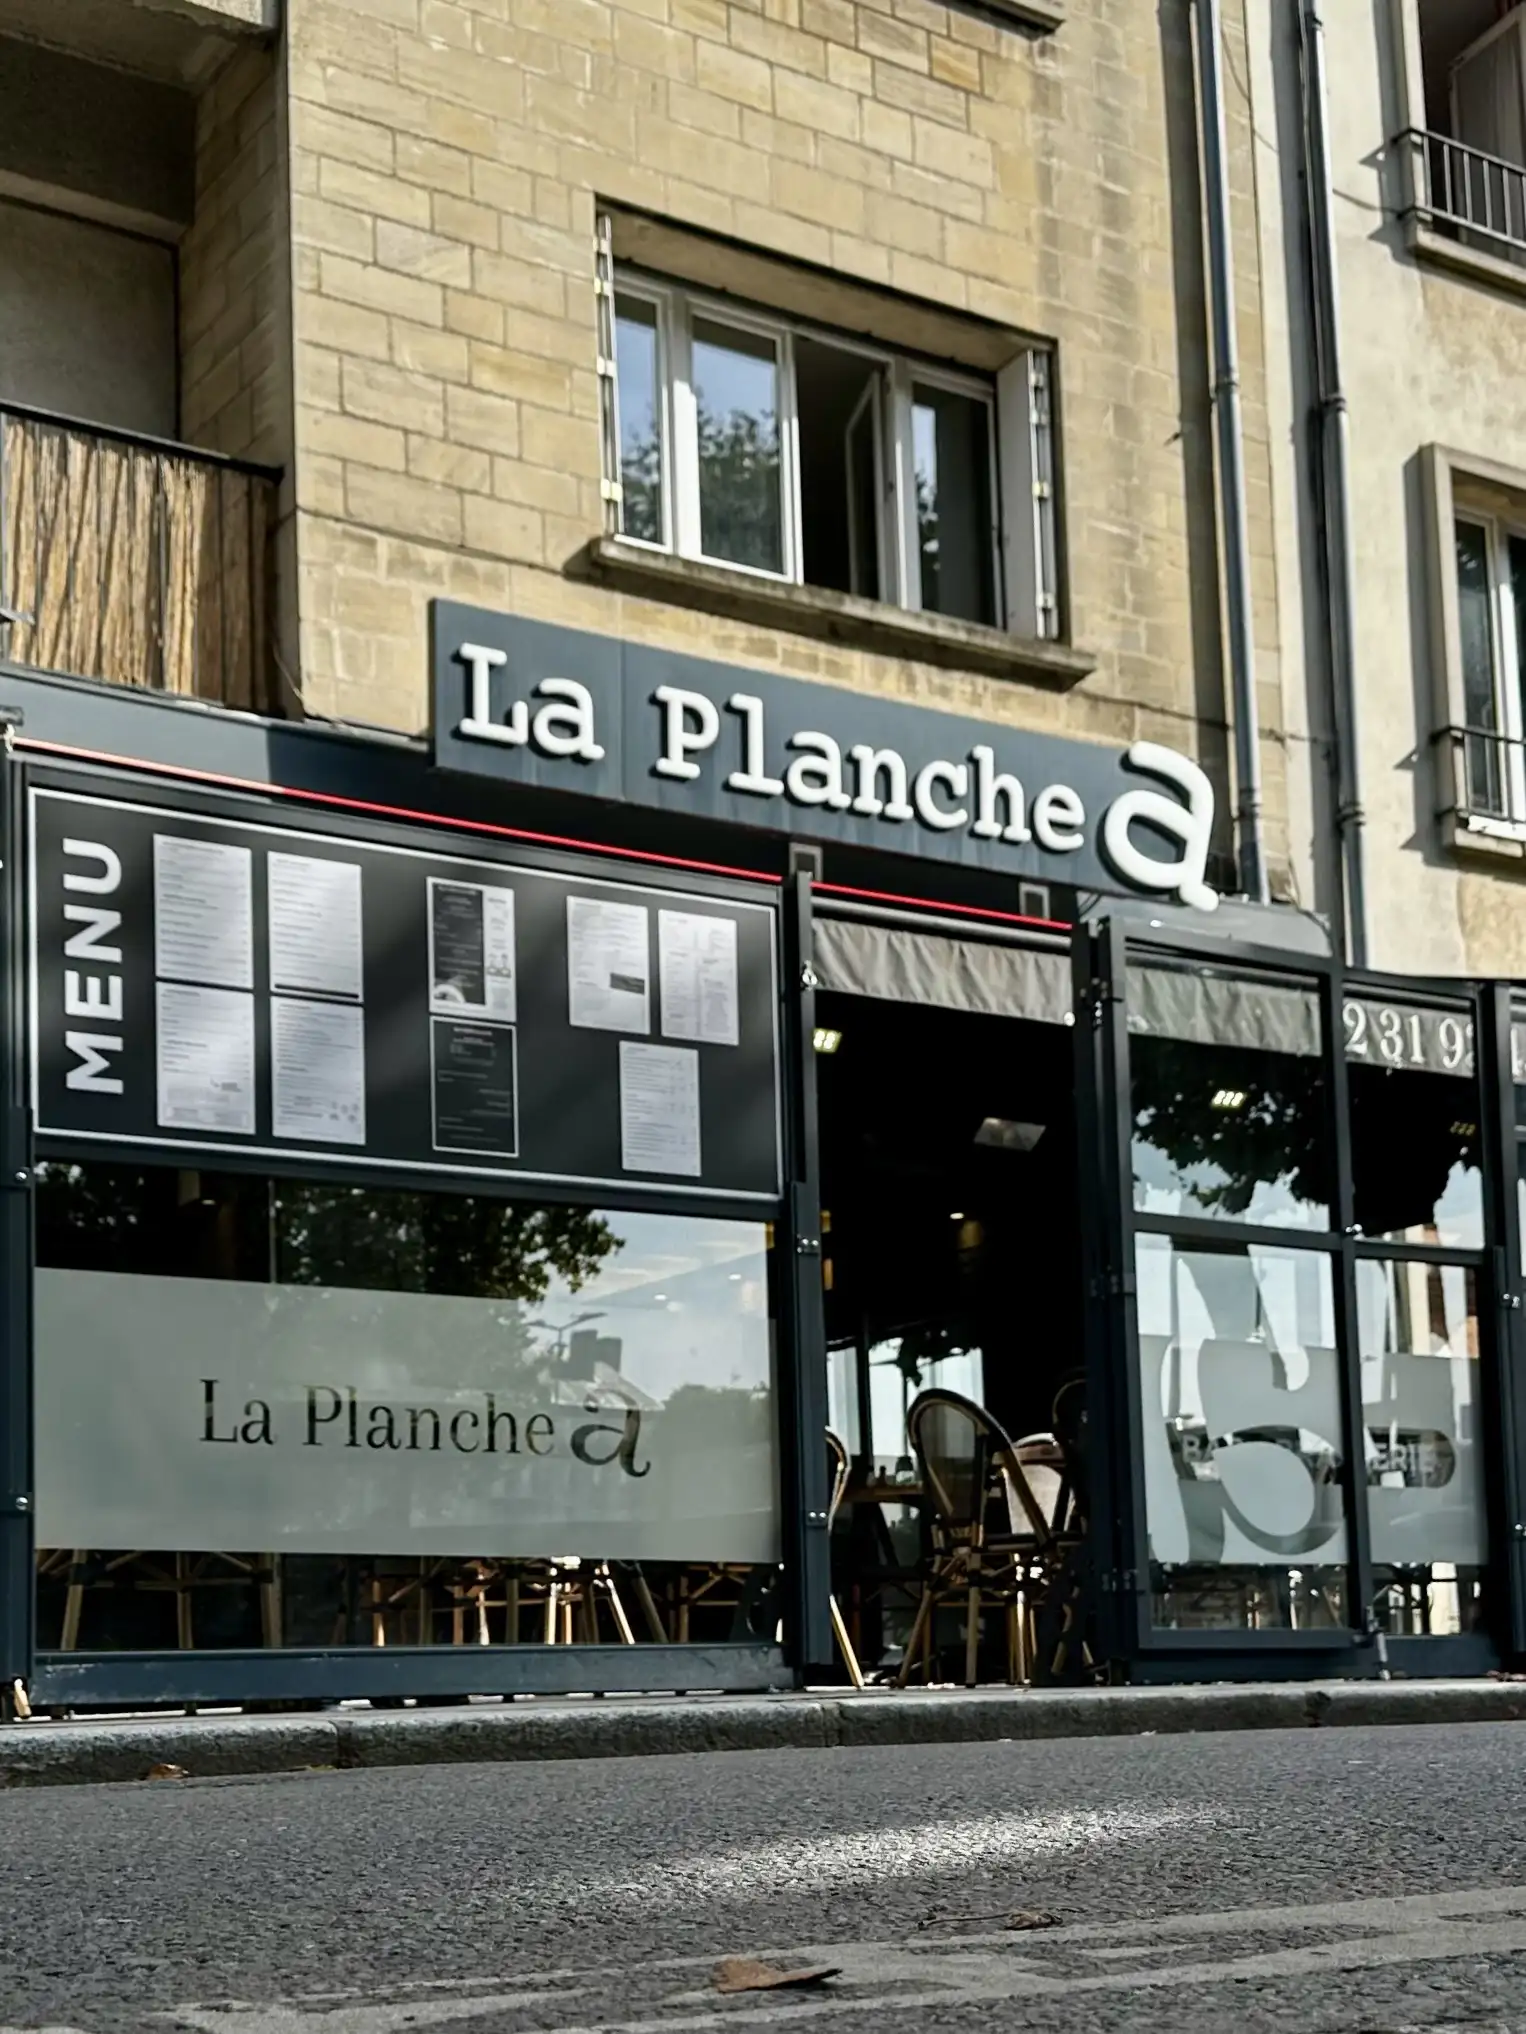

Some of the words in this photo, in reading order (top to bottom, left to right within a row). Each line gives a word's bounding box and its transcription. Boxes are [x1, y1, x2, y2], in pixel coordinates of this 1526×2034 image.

[459, 642, 605, 760] La
[655, 685, 1086, 852] Planche
[1103, 740, 1220, 913] a
[63, 837, 124, 1095] MENU
[199, 1378, 275, 1445] La
[302, 1384, 555, 1456] Planche
[570, 1387, 652, 1478] a
